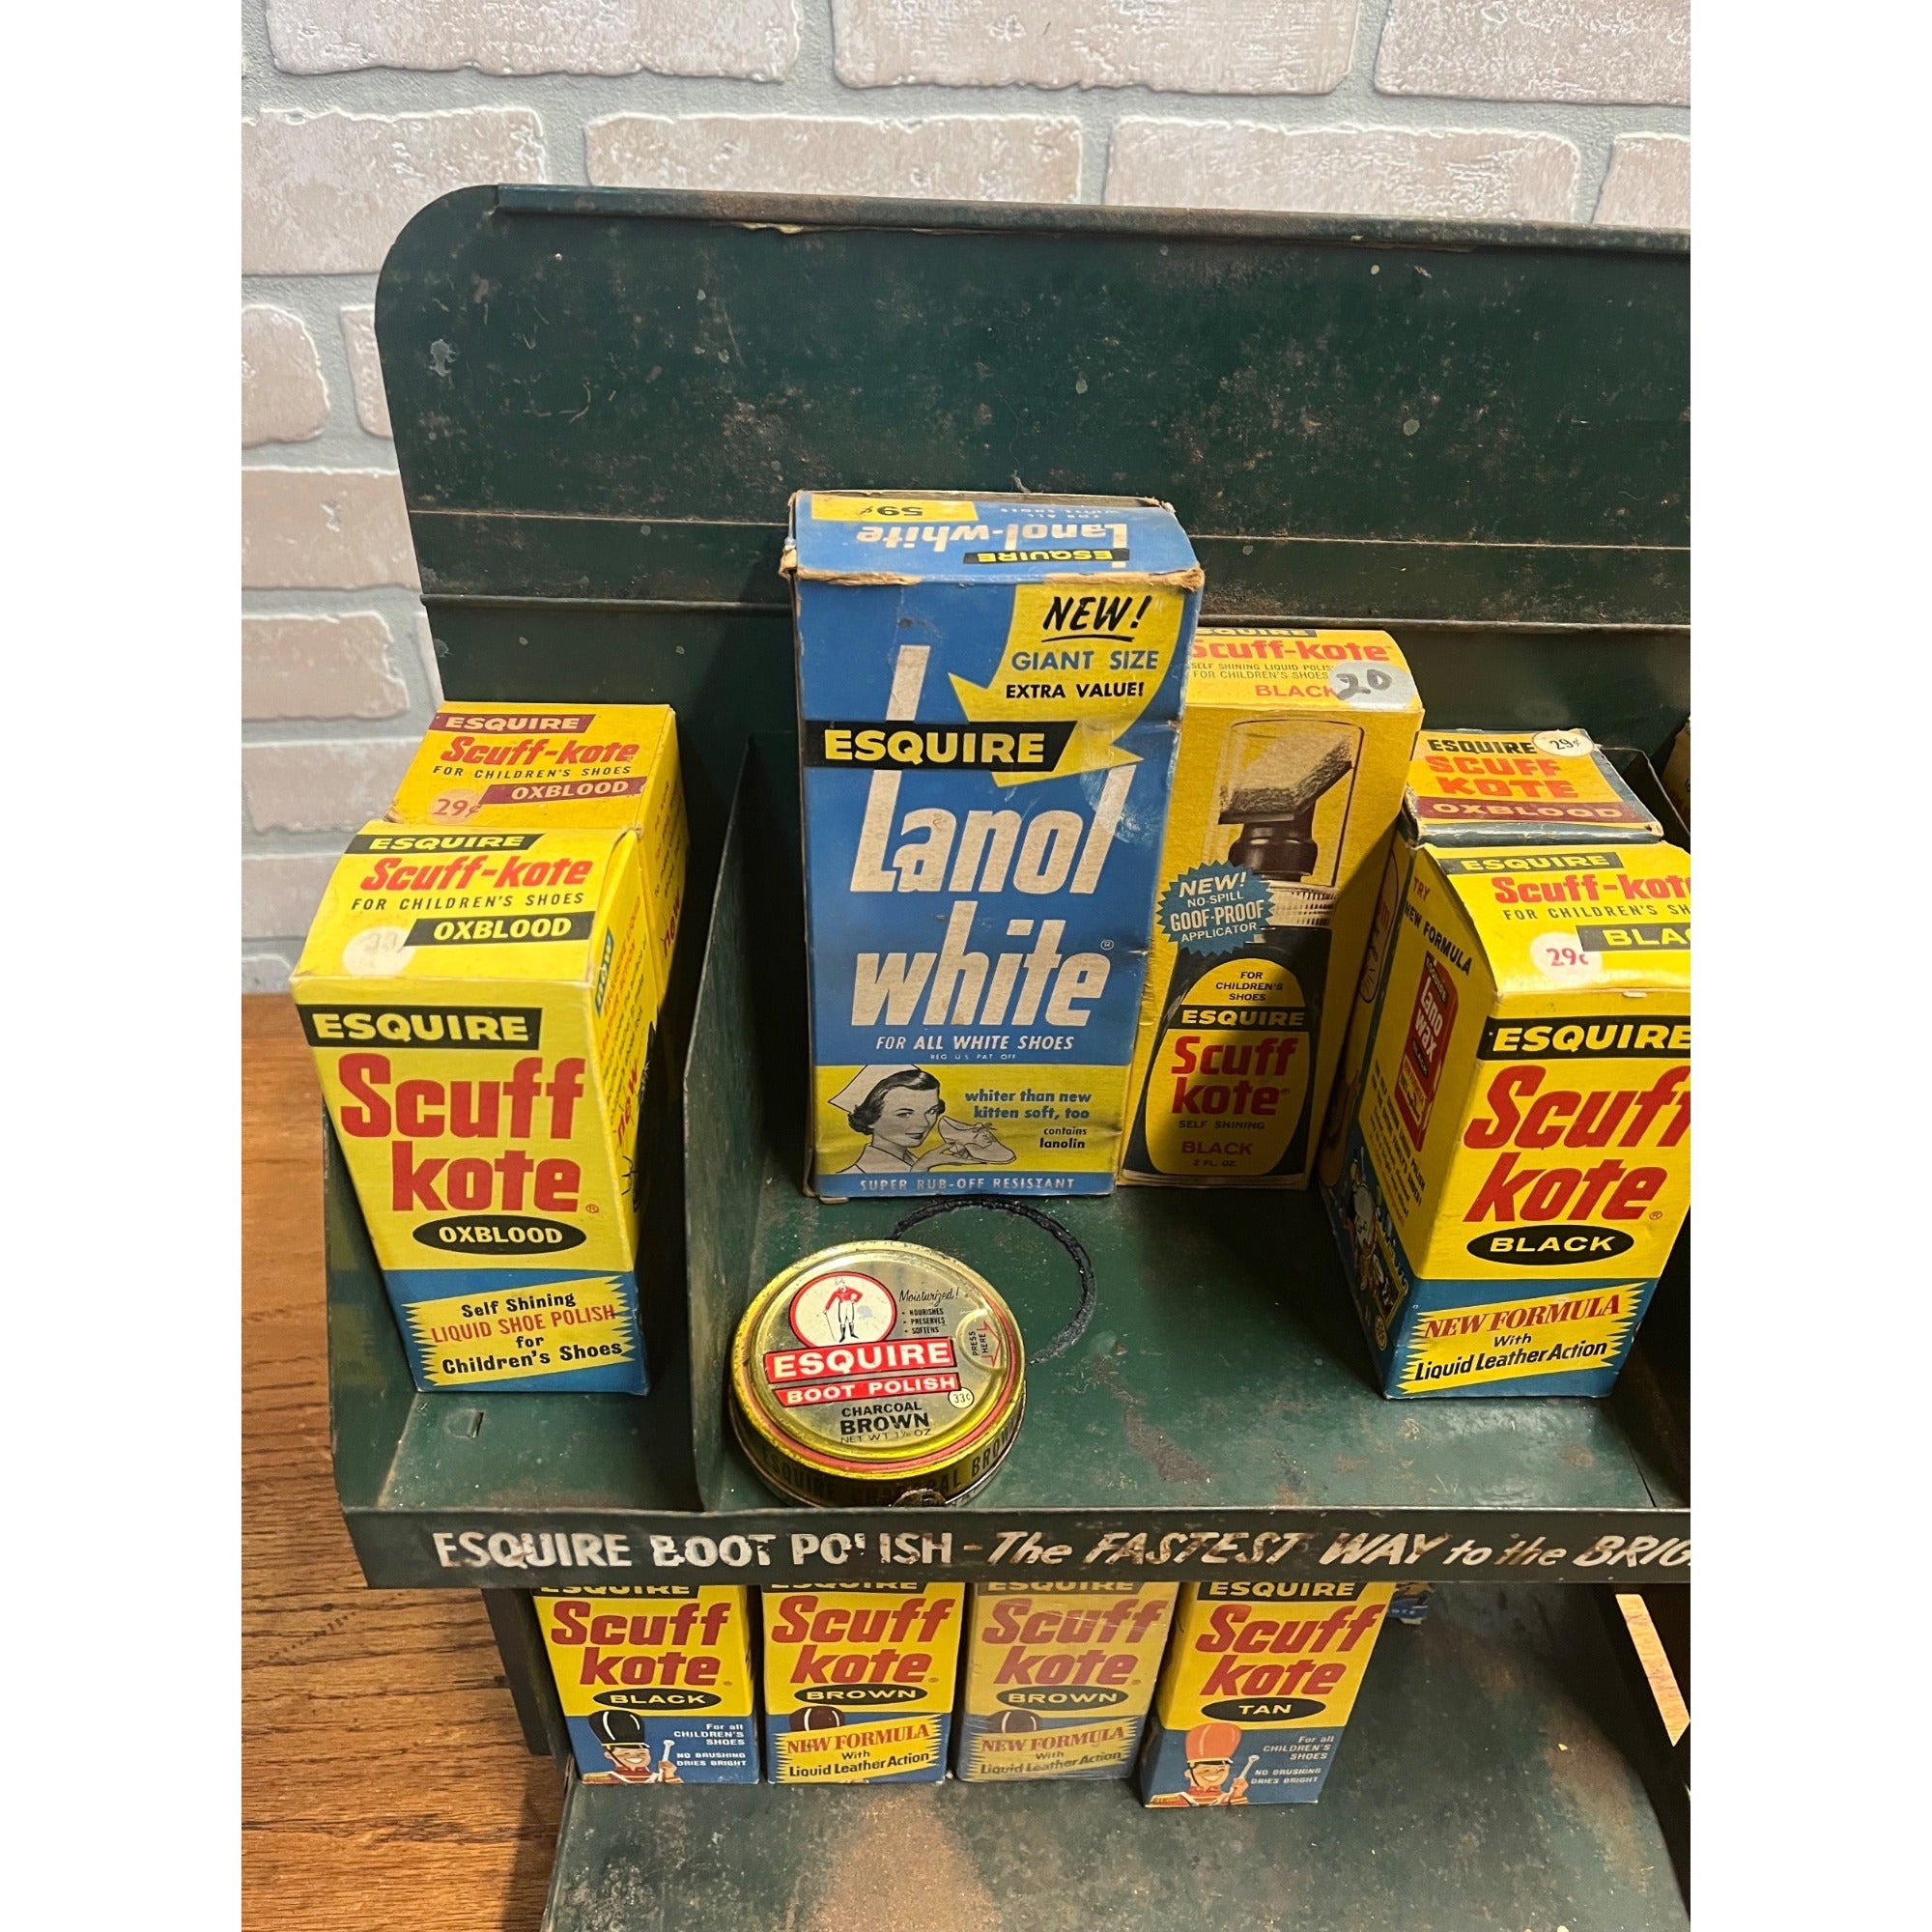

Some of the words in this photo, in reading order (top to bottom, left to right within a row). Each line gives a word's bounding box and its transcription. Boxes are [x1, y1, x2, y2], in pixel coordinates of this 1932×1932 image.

[857, 523, 1128, 568] Lanol-white
[977, 549, 1114, 562] ESQUIRE
[1042, 594, 1152, 631] NEW!
[1011, 650, 1094, 671] GIANT
[1109, 650, 1159, 669] SIZE
[1193, 639, 1389, 661] Scuff-kote
[1193, 670, 1215, 679] FOR
[1221, 670, 1289, 680] CHILDREN'S
[1293, 671, 1328, 680] SHOES
[1218, 663, 1260, 671] SHINING
[1006, 684, 1066, 699] EXTRA
[1076, 682, 1145, 698] VALUE!
[1256, 685, 1338, 697] BLACK
[444, 716, 581, 731] ESQUIRE
[440, 736, 640, 766] Scuff-kote
[824, 729, 1046, 765] ESQUIRE
[1428, 739, 1538, 754] ESQUIRE
[433, 765, 464, 777] FOR
[474, 767, 571, 780] CHILDREN'S
[581, 765, 632, 777] SHOES
[1425, 756, 1561, 776] SCUFF
[511, 781, 630, 802] OXBLOOD
[1437, 778, 1578, 799] KOTE
[1433, 803, 1624, 819] OXBLOOD
[368, 836, 527, 851] ESQUIRE
[1460, 855, 1609, 871] ESQUIRE
[360, 856, 593, 892] Scuff-kote
[1179, 872, 1247, 897] NEW!
[1413, 876, 1431, 898] TRY
[1491, 873, 1690, 904] Scuff-kot
[352, 898, 386, 911] FOR
[399, 895, 513, 911] CHILDREN'S
[525, 893, 584, 907] SHOES
[1186, 891, 1244, 908] NO-SPILL
[1170, 899, 1264, 932] GOOF-PROOF
[1503, 909, 1538, 921] FOR
[1550, 904, 1657, 920] CHILDREN'S
[433, 918, 572, 943] OXBLOOD
[1180, 922, 1258, 943] APPLICATOR
[1404, 904, 1422, 926] NEW
[1423, 921, 1472, 976] FORMULA
[850, 900, 1111, 1026] white
[1240, 970, 1263, 980] FOR
[1215, 981, 1283, 991] CHILDREN'S
[1229, 992, 1266, 1002] SHOES
[1420, 976, 1443, 1037] Lano
[312, 1012, 529, 1042] ESQUIRE
[1181, 1009, 1305, 1026] ESQUIRE
[876, 1035, 907, 1050] FOR
[913, 1035, 944, 1050] ALL
[953, 1035, 1010, 1050] WHITE
[1017, 1035, 1074, 1051] SHOES
[1414, 1008, 1437, 1064] wax
[1493, 1024, 1690, 1053] ESQUIRE
[1171, 1036, 1299, 1076] Scuff
[338, 1052, 585, 1139] Scuff
[965, 1088, 1016, 1103] whiter
[1020, 1089, 1055, 1103] than
[1059, 1093, 1092, 1103] new
[1172, 1076, 1280, 1116] kote
[974, 1105, 1019, 1120] kitten
[1024, 1106, 1060, 1121] soft,
[1065, 1108, 1090, 1120] too
[1043, 1126, 1088, 1136] contains
[1179, 1120, 1208, 1128] SELF
[1214, 1120, 1265, 1130] SHINING
[1039, 1137, 1086, 1150] lanolin
[1181, 1141, 1254, 1155] BLACK
[391, 1140, 580, 1213] kote
[860, 1179, 908, 1191] SUPER
[918, 1178, 985, 1191] RUB-OFF
[993, 1178, 1075, 1190] RESISTANT
[1463, 1151, 1668, 1223] kote
[439, 1226, 563, 1244] OXBLOOD
[1490, 1236, 1616, 1253] BLACK
[461, 1300, 498, 1318] Self
[506, 1293, 577, 1314] Shining
[899, 1287, 959, 1307] Moisturized!
[431, 1322, 493, 1344] LIQUID
[499, 1313, 544, 1335] SHOE
[552, 1304, 616, 1328] POLISH
[1424, 1313, 1492, 1339] NEW
[1487, 1294, 1620, 1331] FORMULA
[516, 1334, 545, 1350] for
[969, 1331, 980, 1356] PRESS
[979, 1333, 989, 1354] HERE
[1493, 1333, 1532, 1348] With
[442, 1350, 551, 1376] Children's
[559, 1341, 623, 1361] Shoes
[774, 1342, 952, 1378] ESQUIRE
[1414, 1354, 1473, 1381] Liquid
[1475, 1349, 1548, 1372] Leather
[1546, 1341, 1608, 1362] Action
[786, 1385, 855, 1405] BOOT
[868, 1376, 956, 1396] POLISH
[841, 1402, 922, 1417] CHARCOAL
[840, 1412, 929, 1435] BROWN
[869, 1433, 890, 1441] WT
[914, 1429, 932, 1437] OZ
[433, 1532, 633, 1571] ESQUIRE
[650, 1534, 776, 1568] BOOT
[792, 1532, 952, 1568] POISH
[987, 1532, 1074, 1568] The
[1084, 1532, 1300, 1568] FASTEST
[1319, 1532, 1447, 1567] WAY
[1449, 1541, 1492, 1567] to
[1493, 1537, 1567, 1567] the
[1572, 1535, 1690, 1567] BRIG
[1208, 1581, 1356, 1598] ESQUIRE
[551, 1601, 731, 1646] Scuff
[771, 1595, 956, 1643] Scuff
[981, 1598, 1169, 1644] Scuff
[1195, 1604, 1387, 1653] Scuff
[580, 1647, 721, 1686] kote
[790, 1645, 933, 1685] kote
[993, 1646, 1137, 1686] kote
[1200, 1654, 1348, 1696] kote
[610, 1692, 707, 1705] BLACK
[806, 1688, 918, 1700] BROWN
[1008, 1690, 1119, 1704] BROWN
[1237, 1703, 1293, 1716] TAN
[787, 1738, 831, 1754] NEW
[835, 1723, 930, 1750] FORMULA
[980, 1738, 1030, 1753] NEW
[1031, 1725, 1125, 1750] FORMULA
[1263, 1744, 1331, 1753] CHILDREN'S
[1297, 1735, 1319, 1745] For
[1321, 1735, 1335, 1744] all
[789, 1765, 832, 1777] Liquid
[834, 1760, 886, 1775] Leather
[888, 1751, 929, 1768] Action
[841, 1750, 870, 1760] With
[980, 1763, 1025, 1776] Liquid
[1026, 1759, 1080, 1774] Leather
[1079, 1751, 1122, 1767] Action
[1036, 1749, 1065, 1760] With
[1290, 1752, 1328, 1761] SHOES
